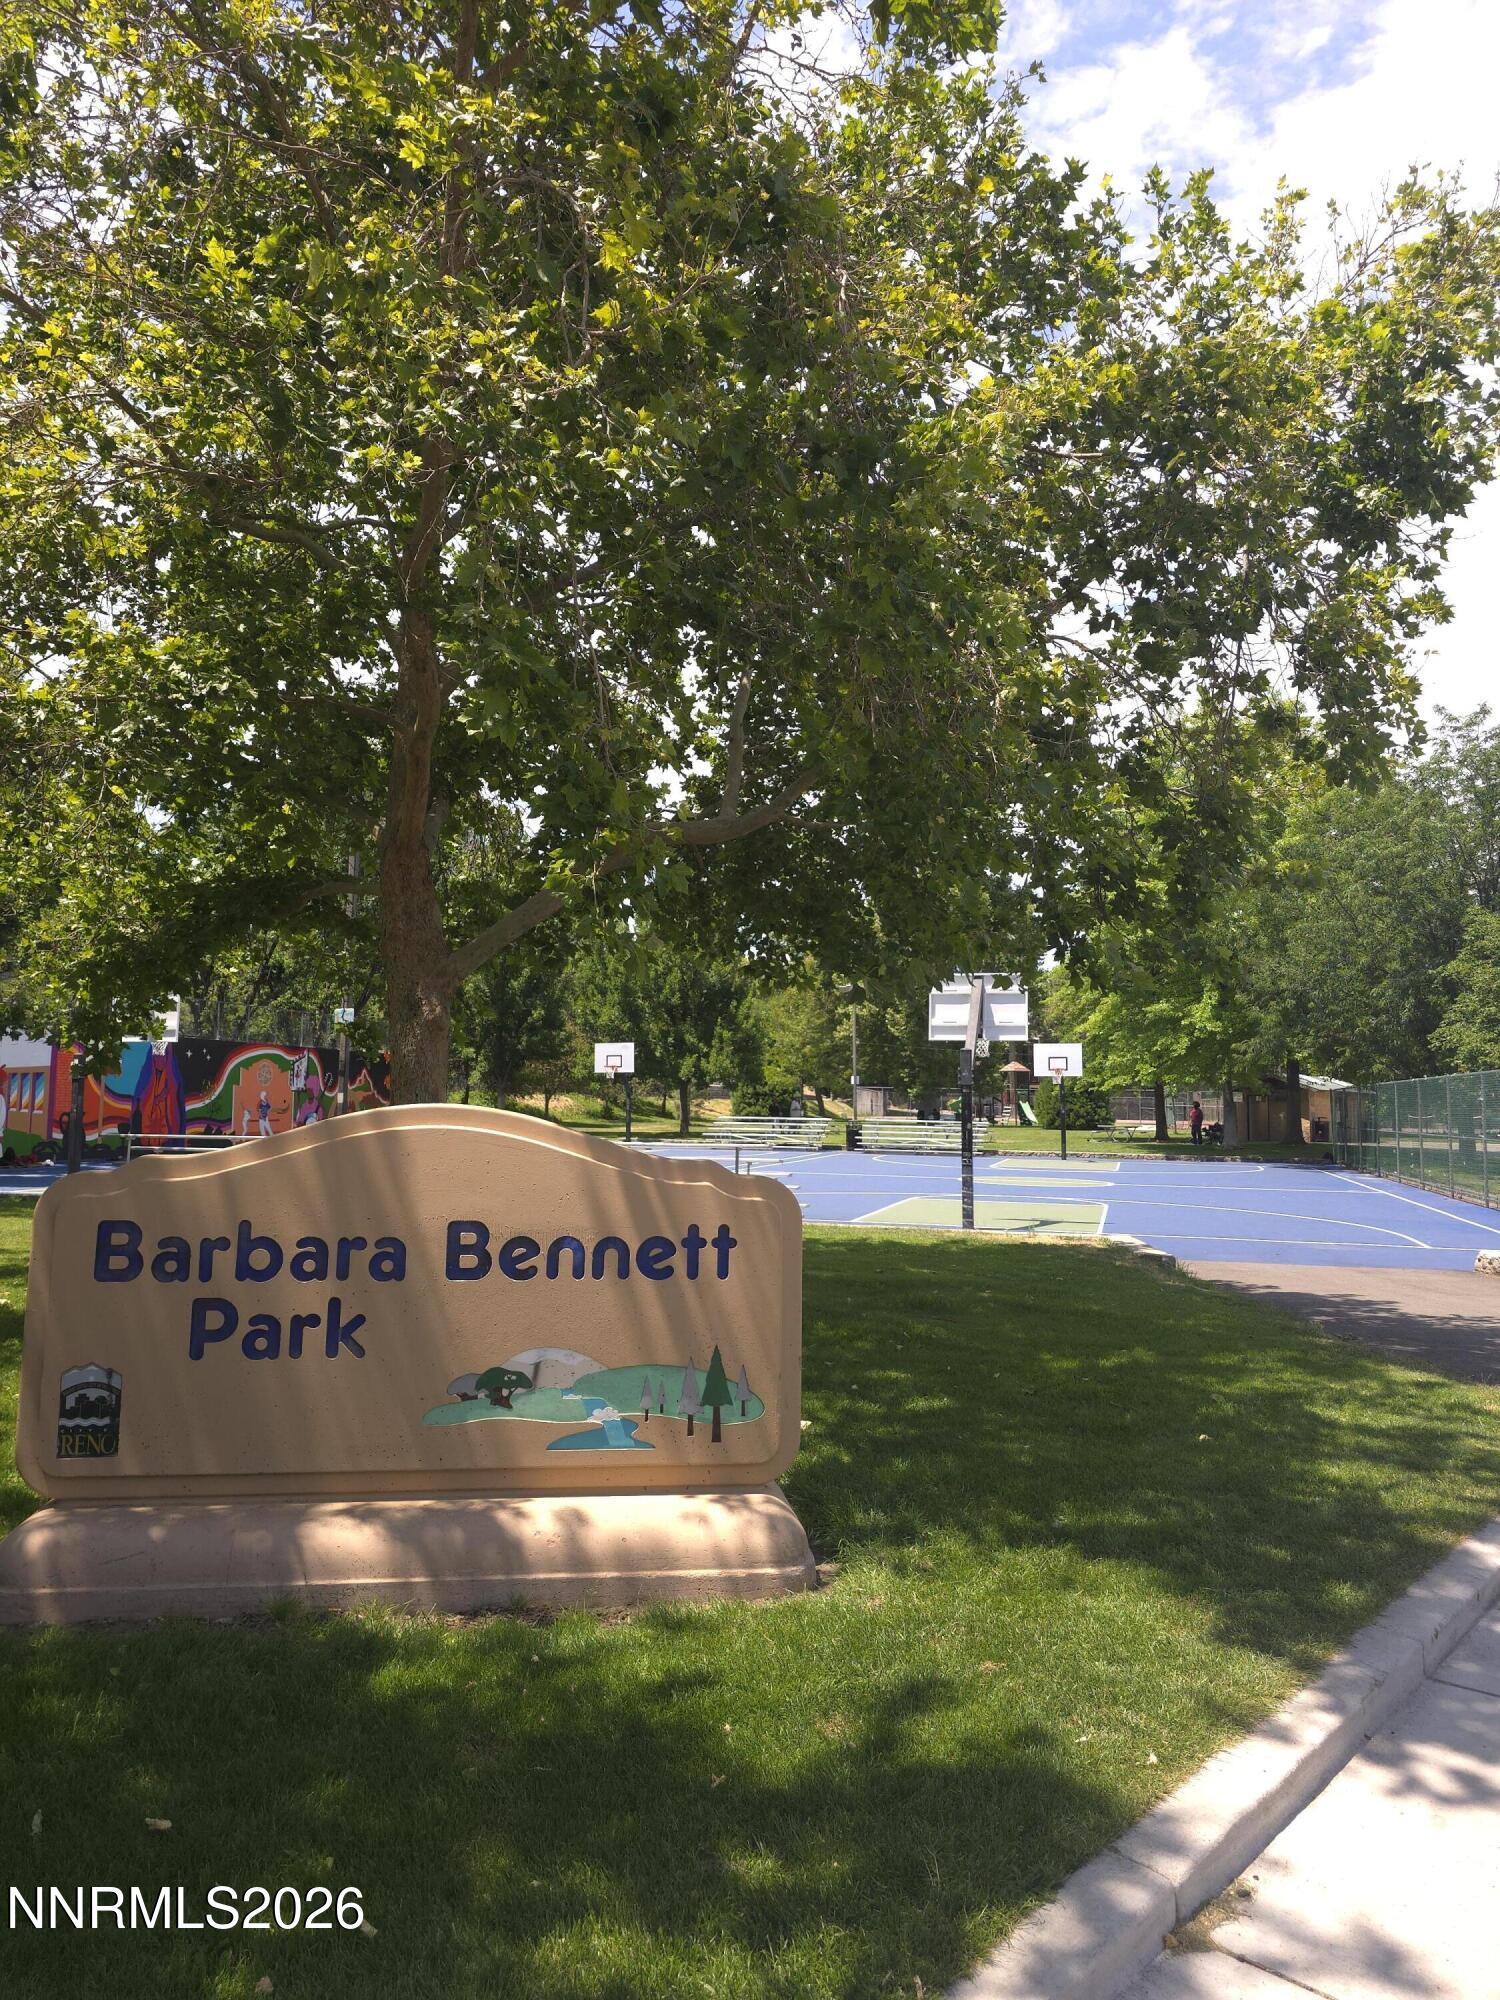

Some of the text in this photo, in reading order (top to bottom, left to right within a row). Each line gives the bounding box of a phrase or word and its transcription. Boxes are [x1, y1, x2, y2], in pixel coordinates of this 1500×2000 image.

[93, 1219, 738, 1283] Barbara Bennett
[188, 1296, 367, 1361] Park
[60, 1433, 116, 1456] RENO
